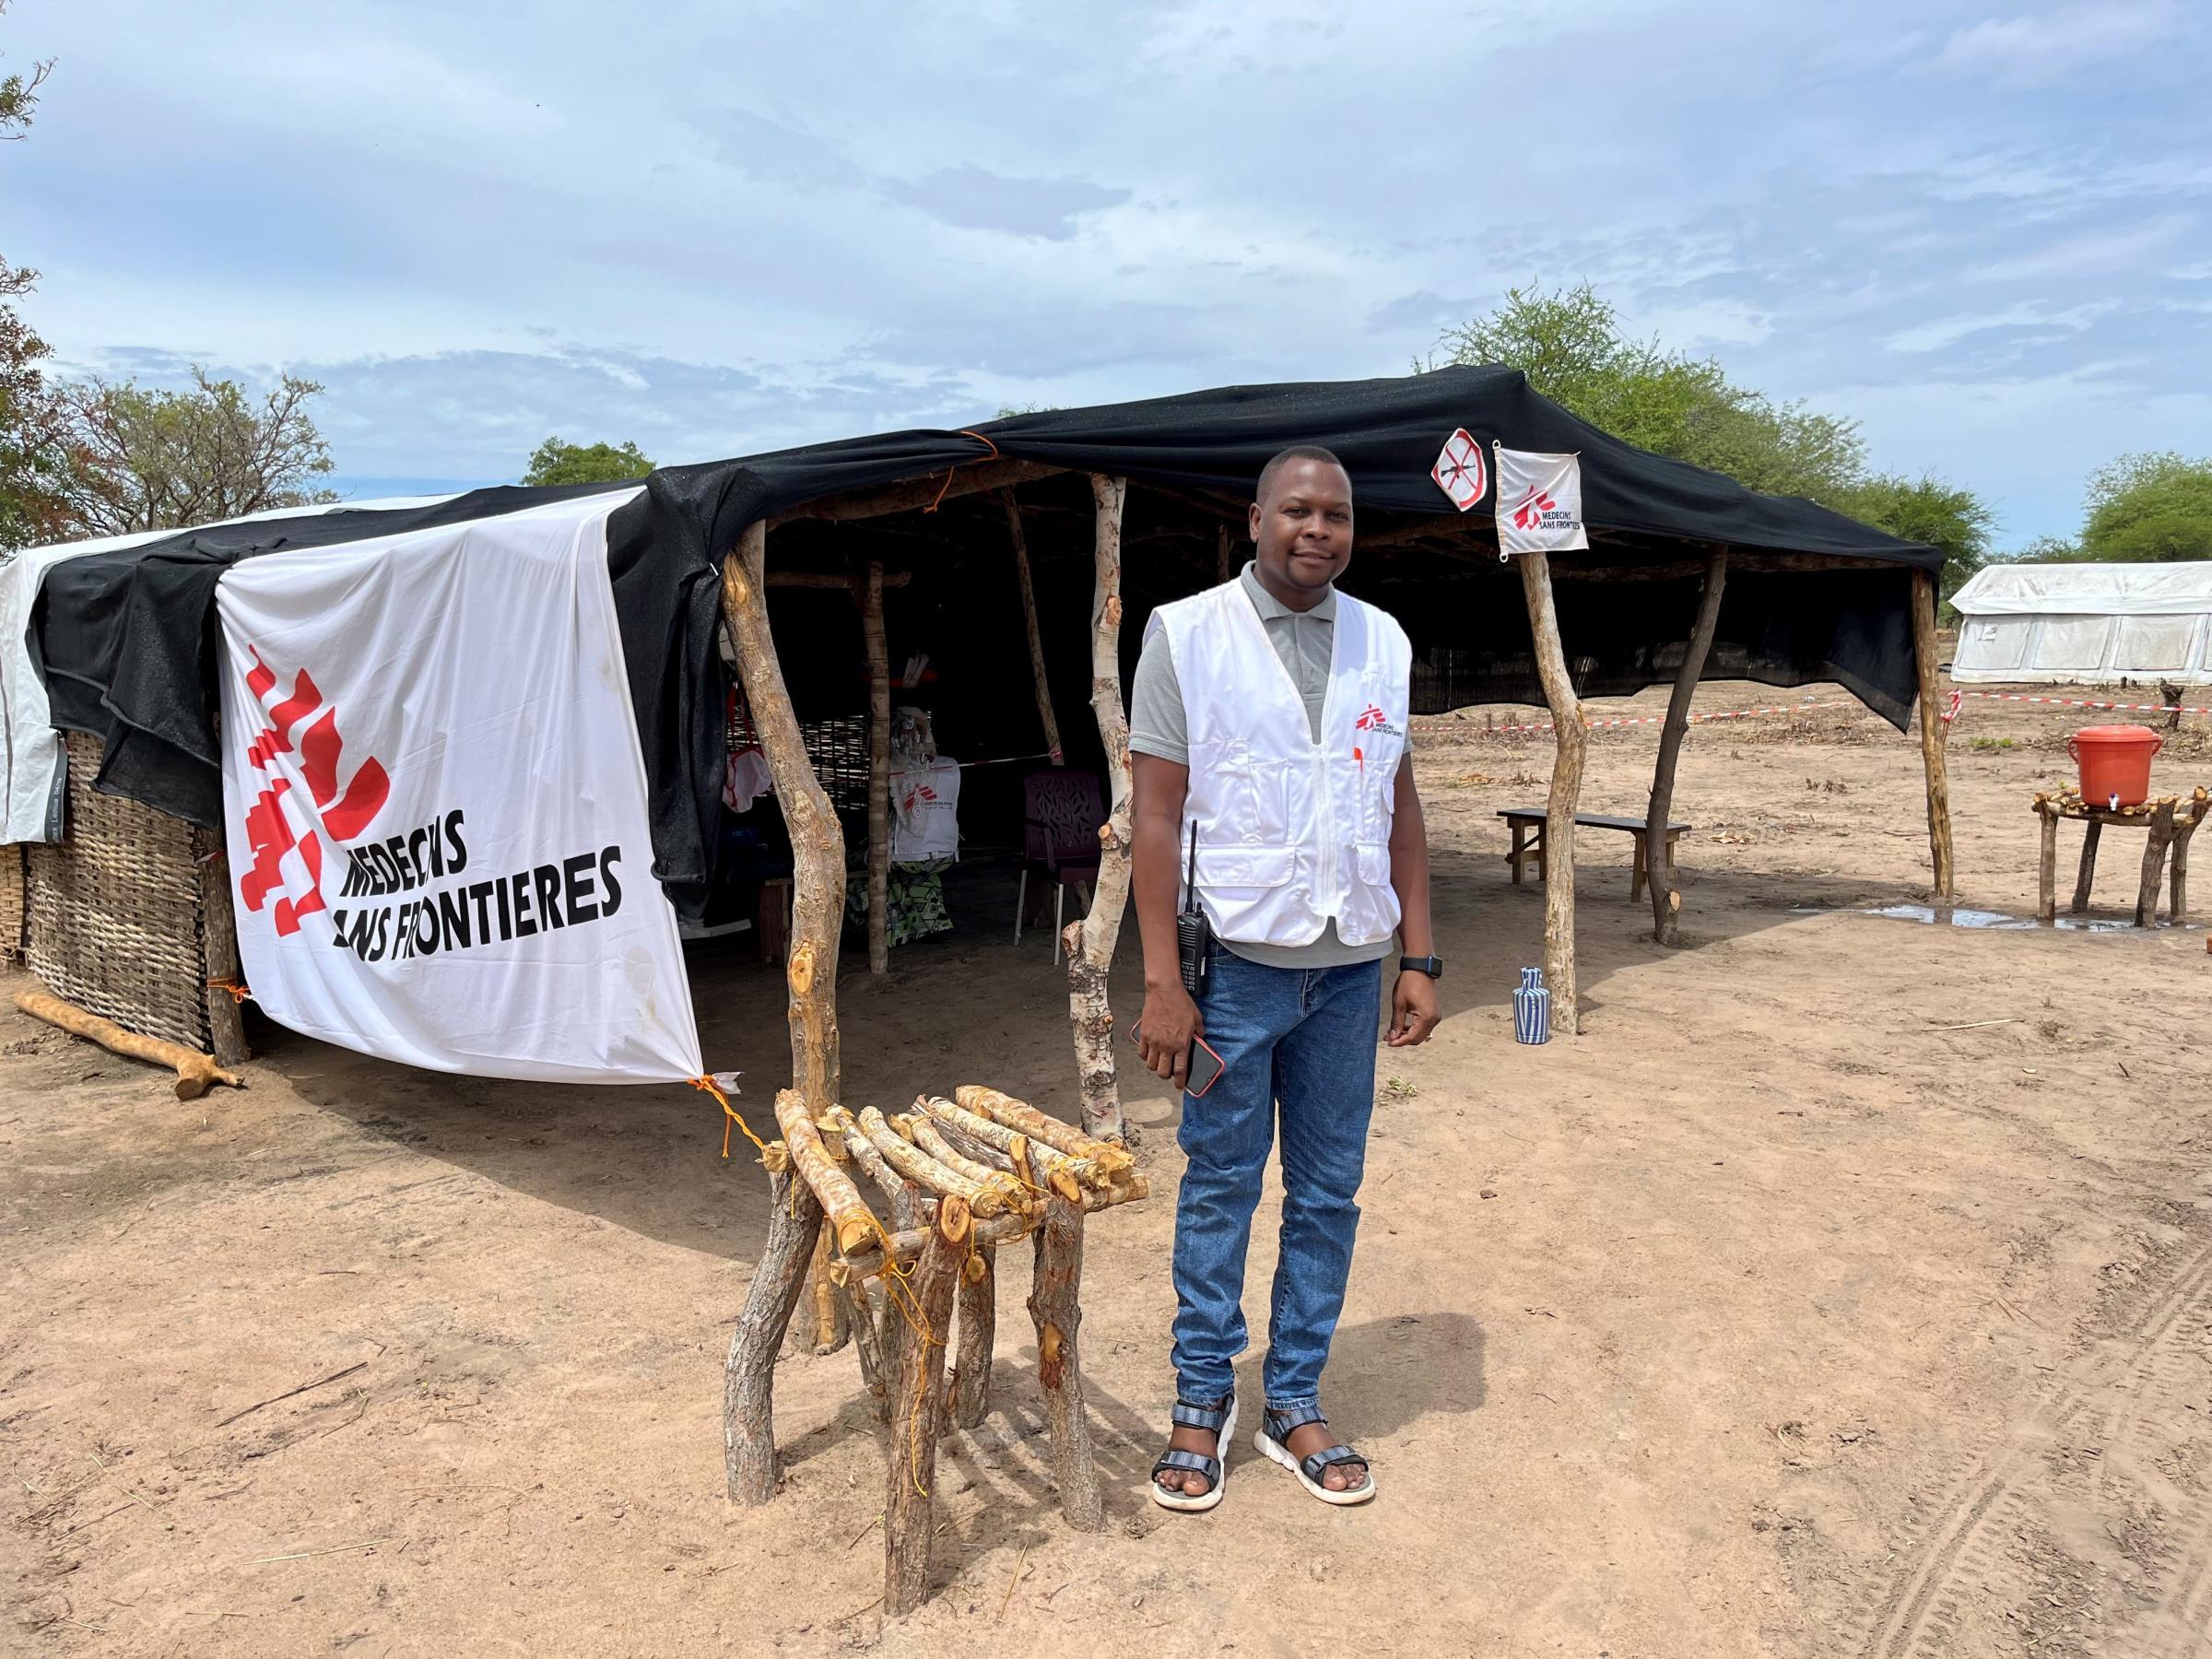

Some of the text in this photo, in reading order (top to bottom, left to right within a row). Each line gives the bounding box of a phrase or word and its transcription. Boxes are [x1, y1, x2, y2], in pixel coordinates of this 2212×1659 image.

[1539, 521, 1555, 530] SANS
[1542, 511, 1571, 520] MEDECINS
[339, 808, 467, 897] MEDECNS
[333, 845, 623, 961] ANS FRONTIERES
